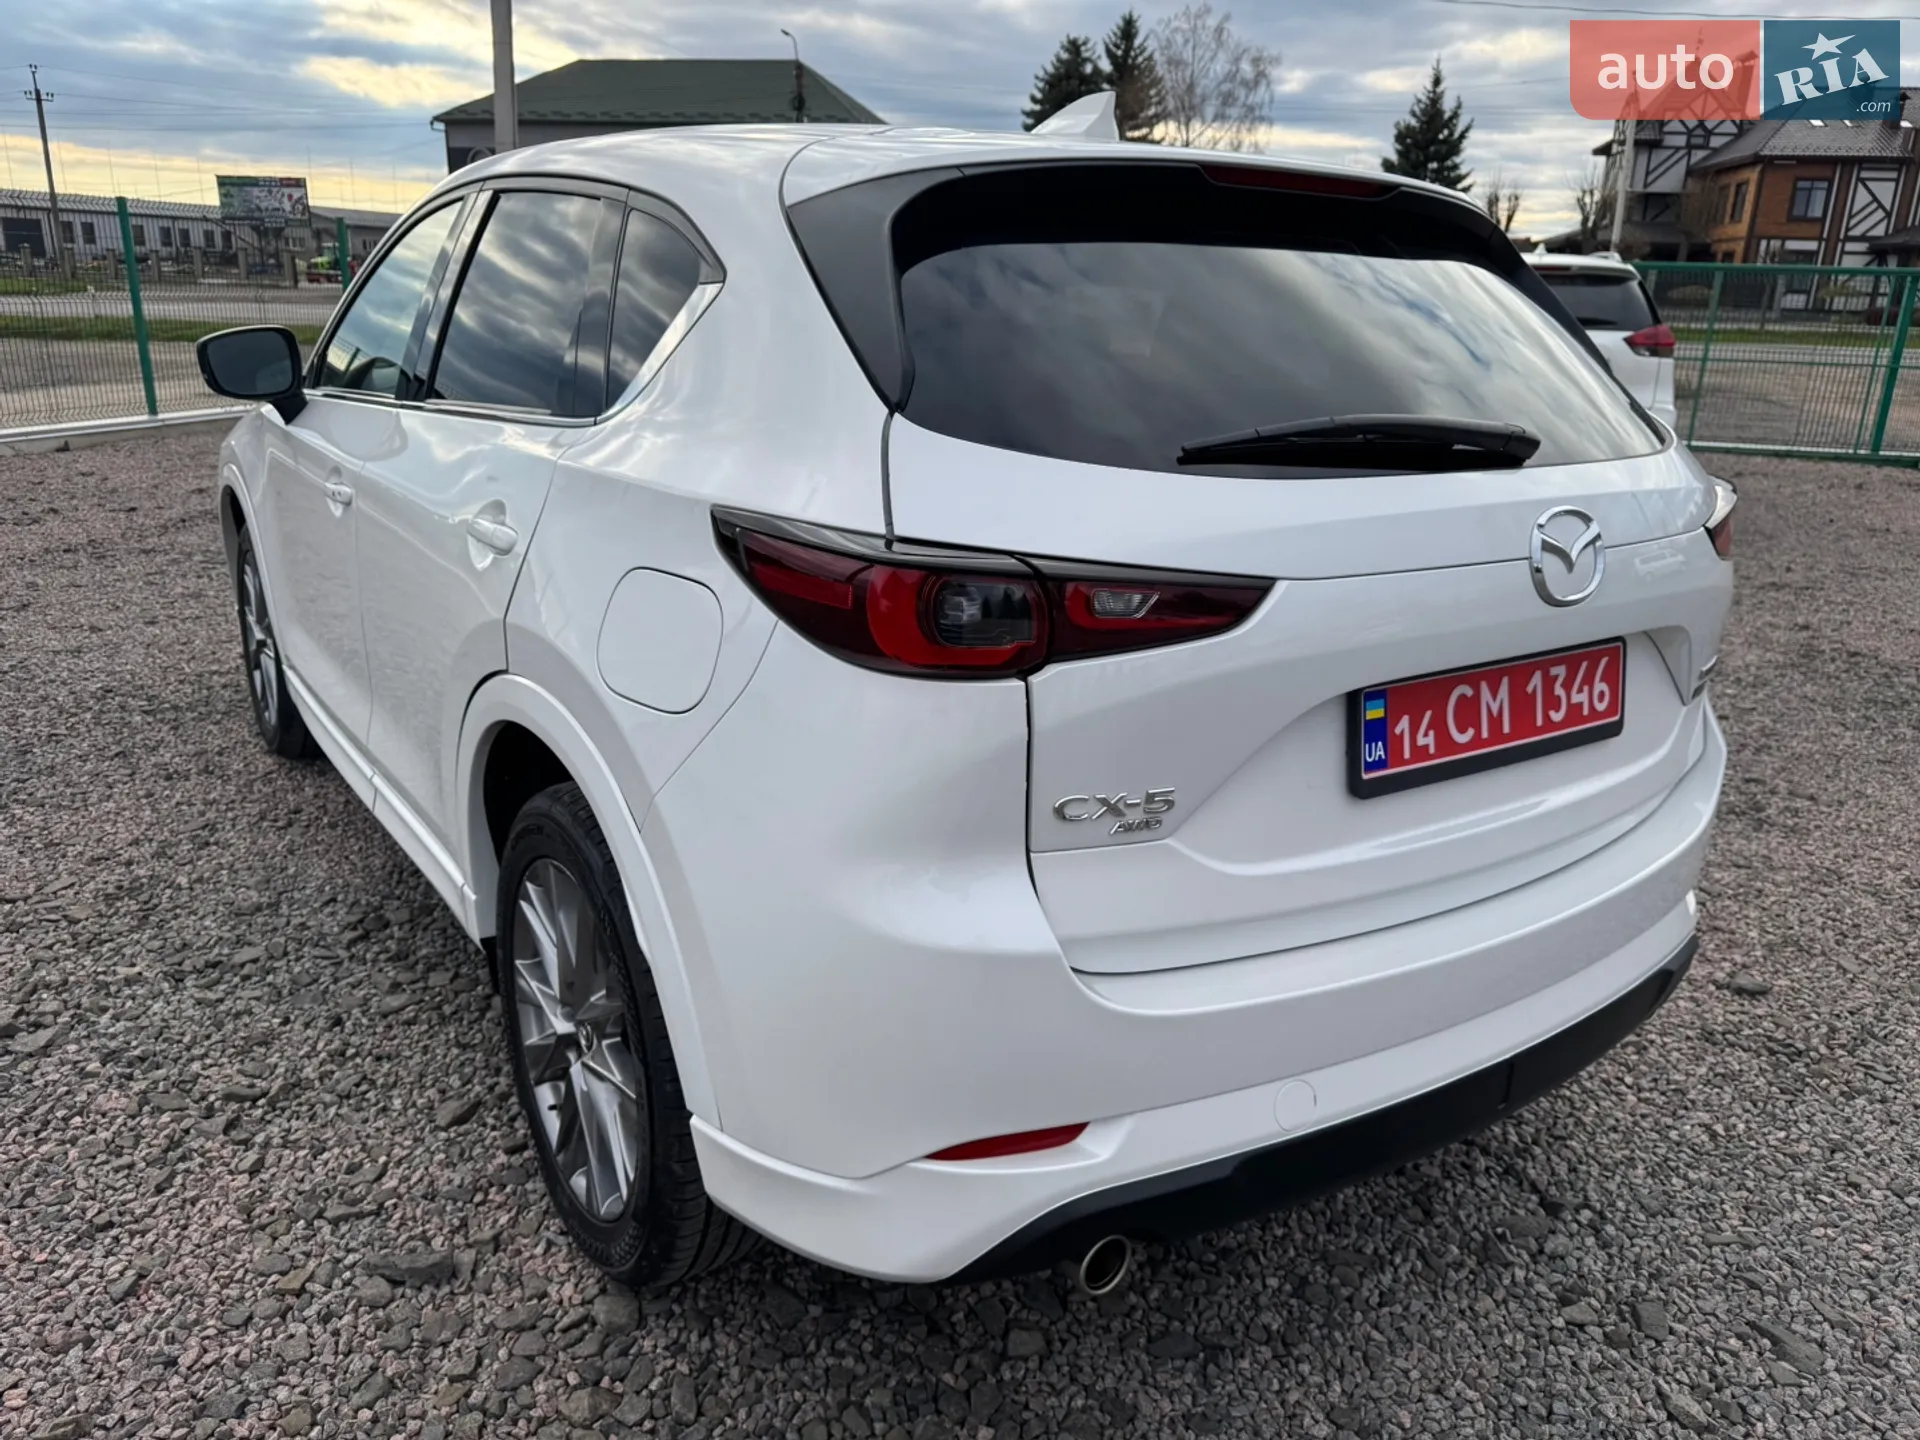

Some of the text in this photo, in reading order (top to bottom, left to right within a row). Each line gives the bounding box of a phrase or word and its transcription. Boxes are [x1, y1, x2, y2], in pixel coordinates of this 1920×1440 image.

[1394, 656, 1610, 760] 14 CM 1346
[1365, 741, 1386, 762] UA
[1053, 787, 1175, 821] CX-5
[1108, 816, 1162, 835] AWD
